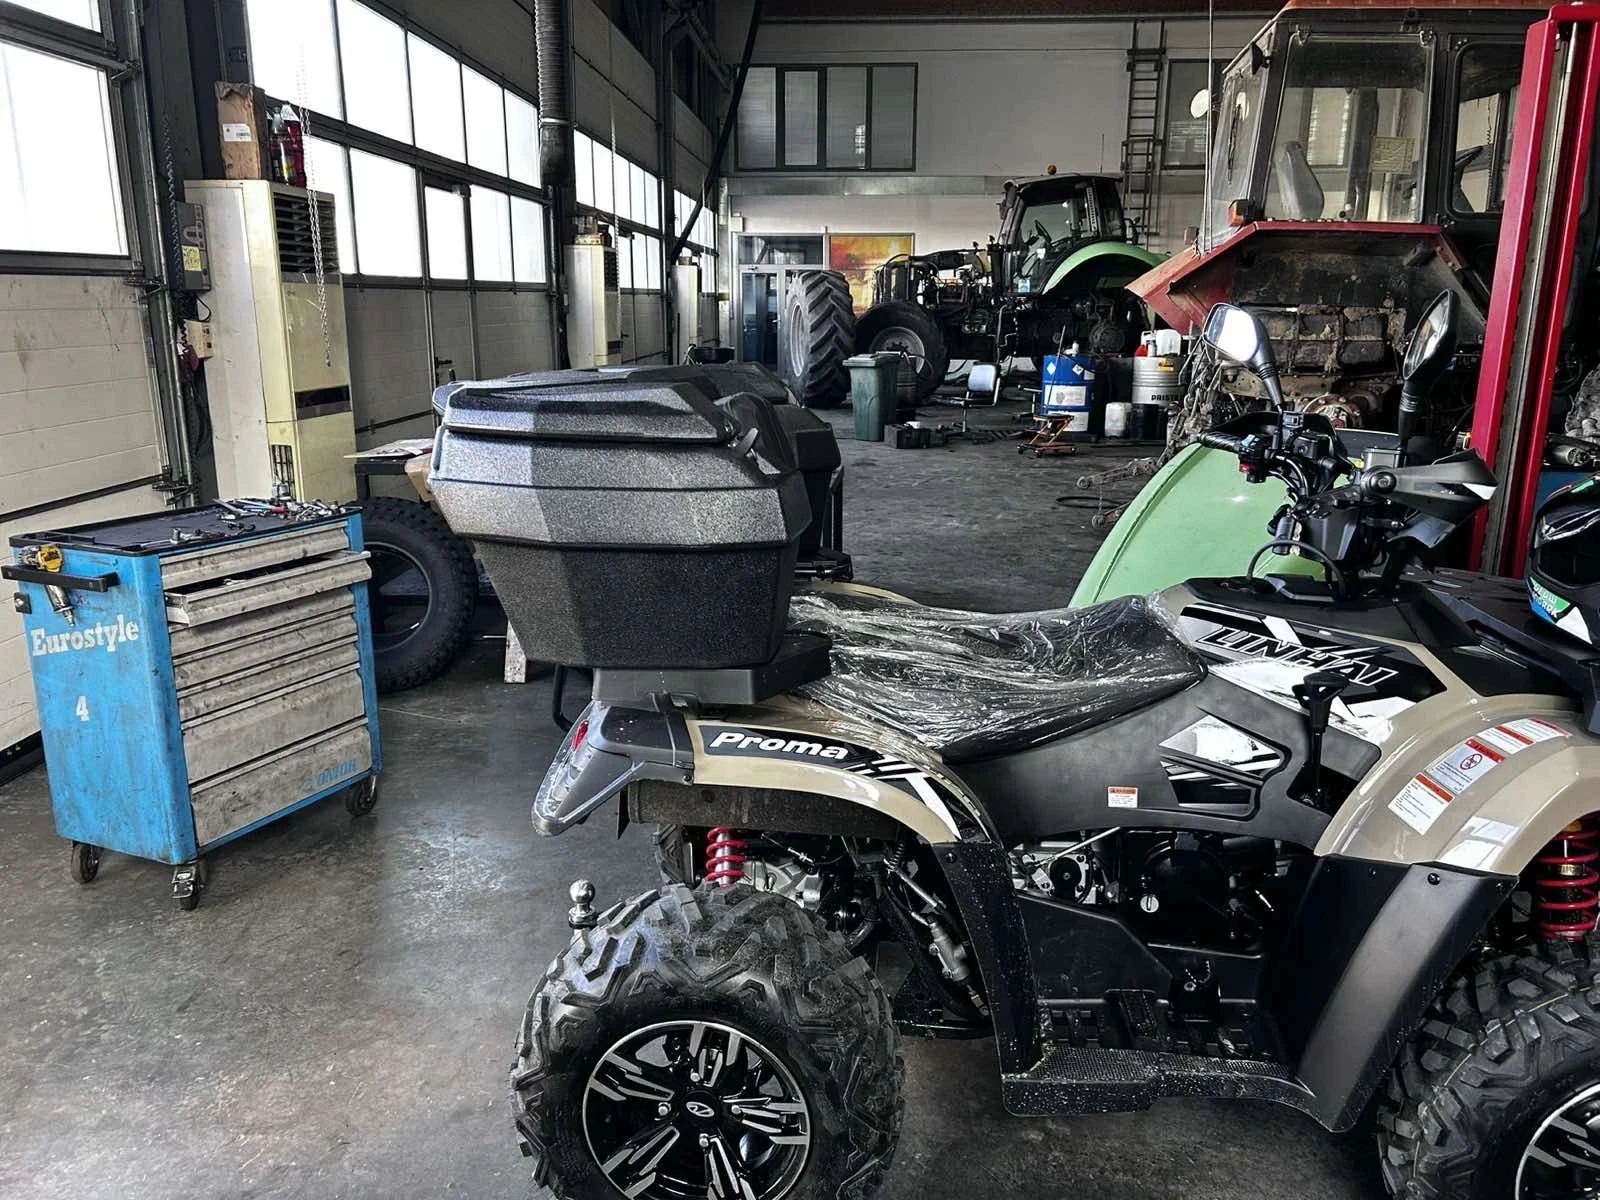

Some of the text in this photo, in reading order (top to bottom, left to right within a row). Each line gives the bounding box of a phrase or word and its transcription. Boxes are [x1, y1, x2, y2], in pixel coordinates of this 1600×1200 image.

[31, 614, 139, 657] Eurostyle
[1195, 626, 1399, 687] LINHAI
[75, 695, 90, 721] 4
[709, 731, 848, 760] Proma
